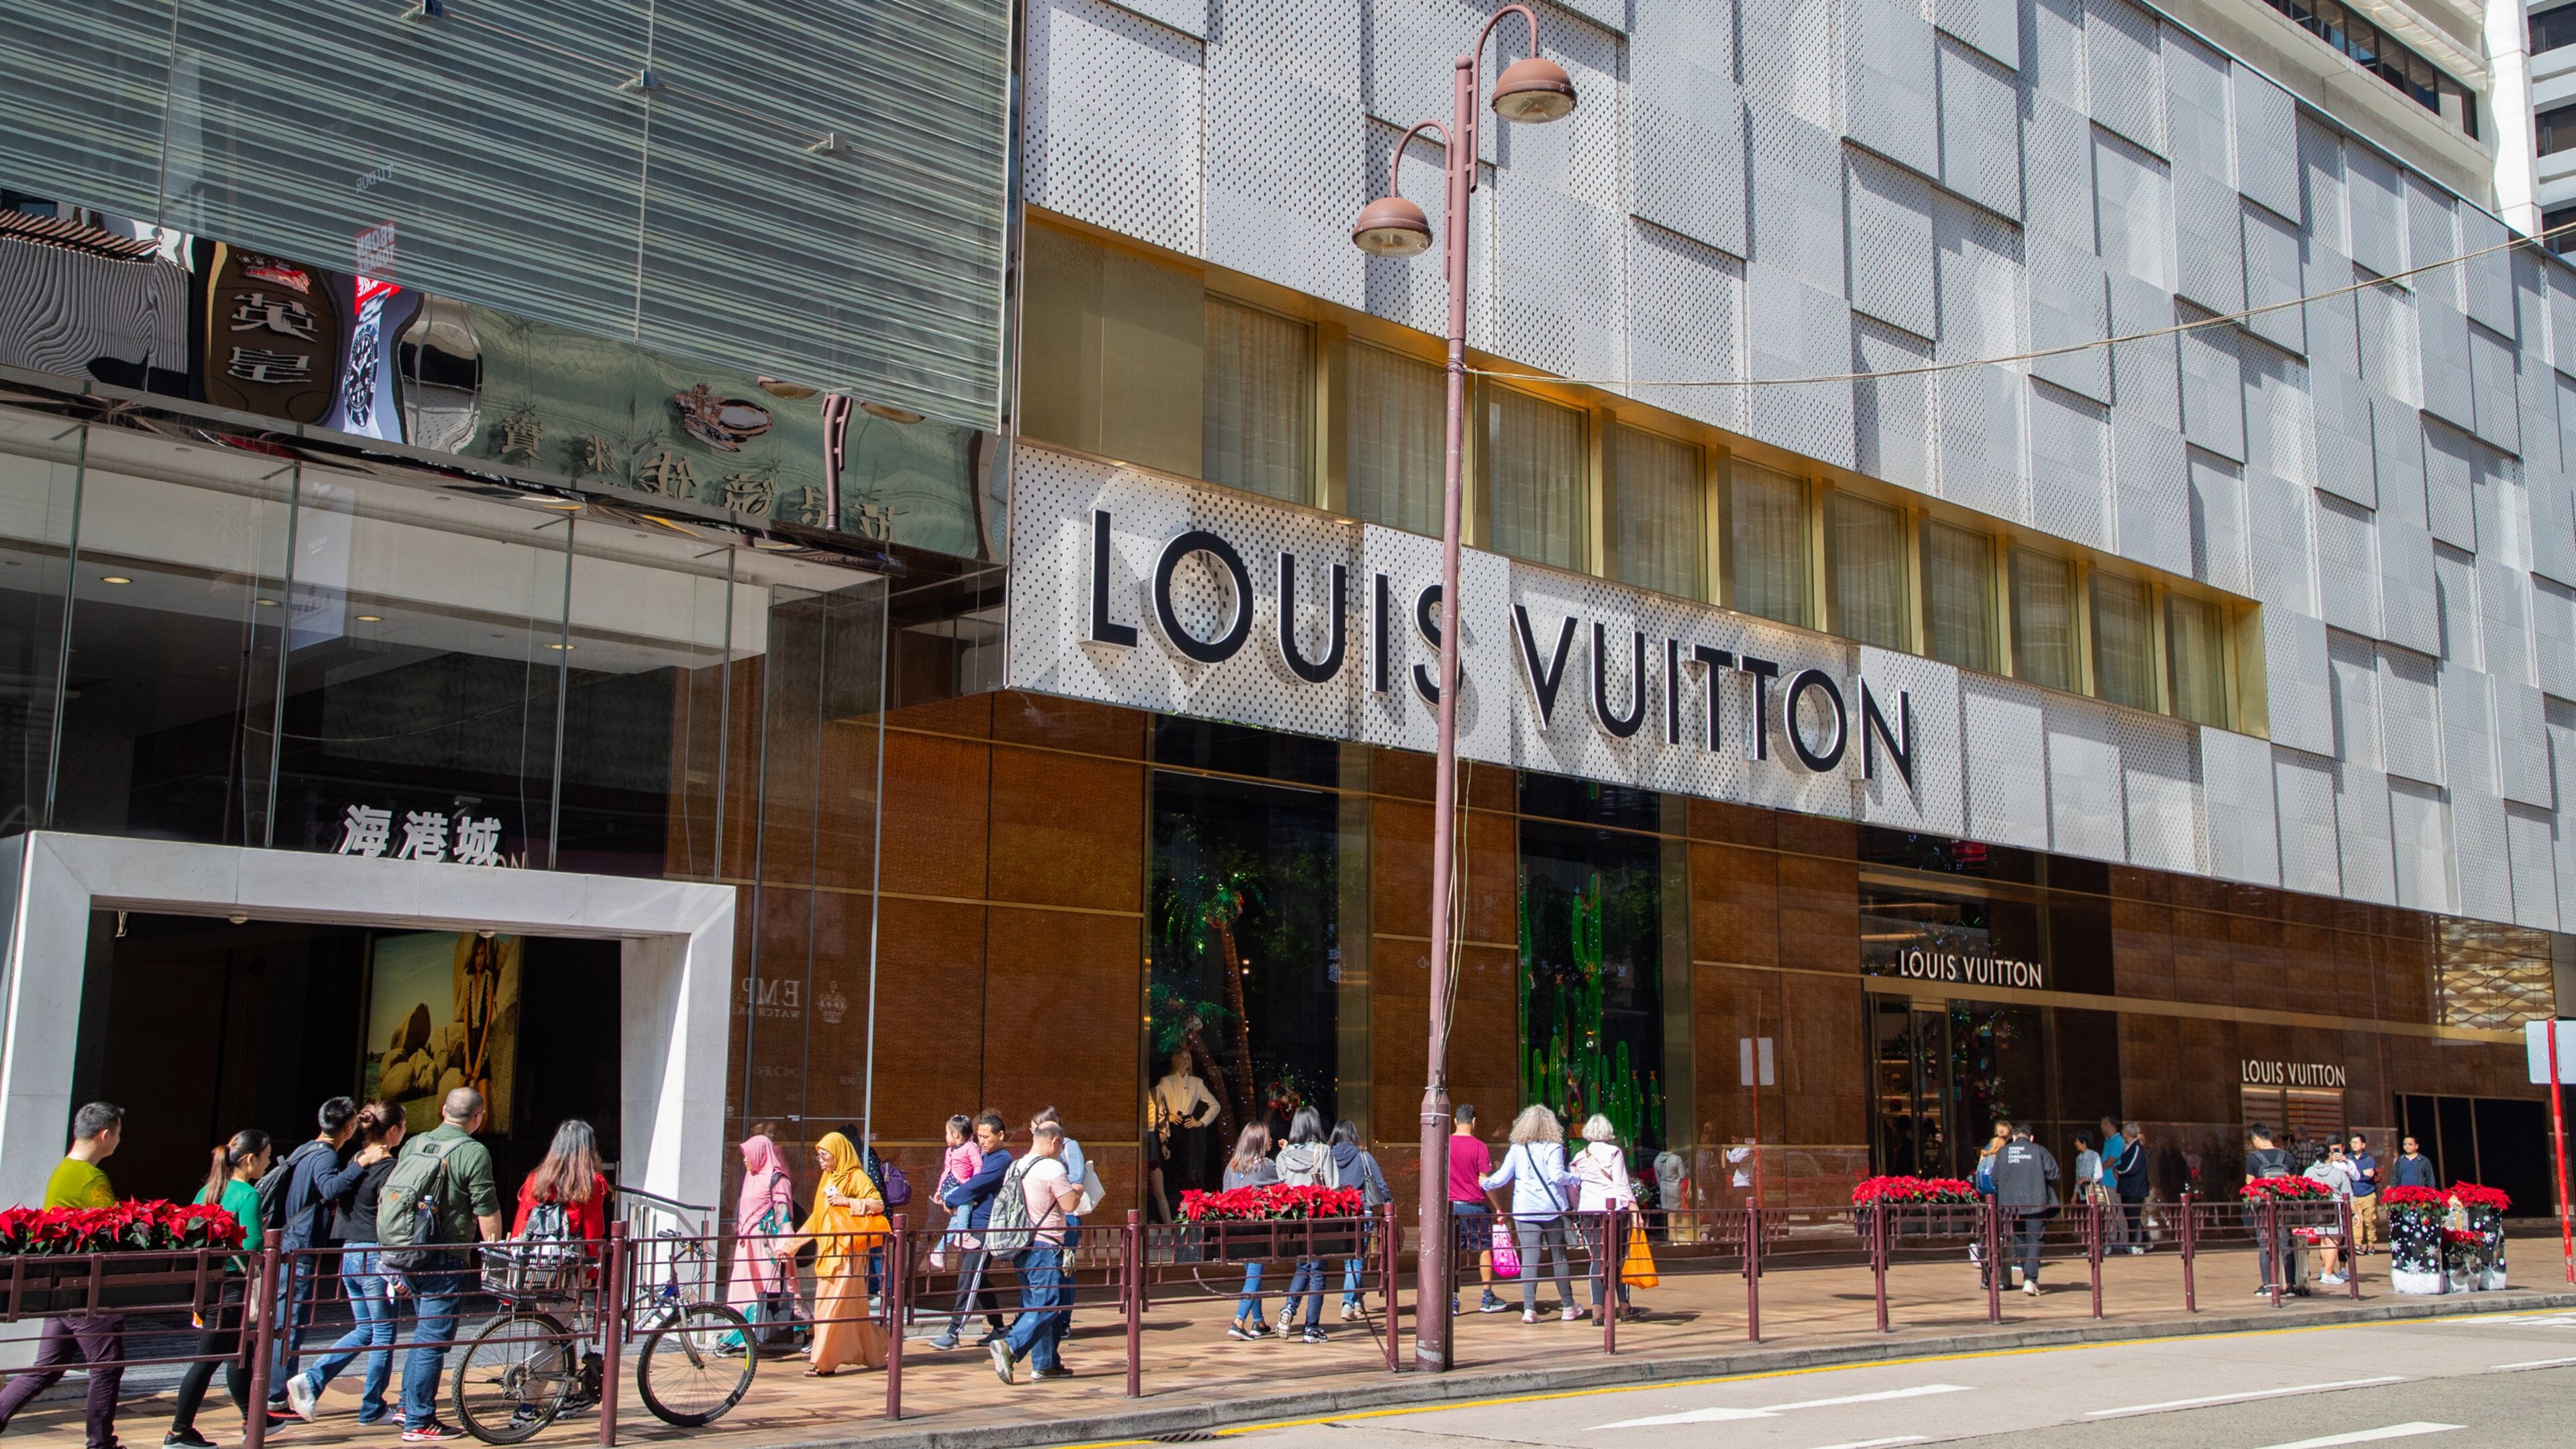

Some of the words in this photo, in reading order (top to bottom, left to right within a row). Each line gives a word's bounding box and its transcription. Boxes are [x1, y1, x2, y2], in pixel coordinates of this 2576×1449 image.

[1090, 508, 1463, 705] LOUIS
[1510, 604, 1912, 794] VUITTON
[338, 804, 502, 867] 海港城
[1900, 949, 1957, 981] LOUIS
[1962, 955, 2043, 989] VUITTON
[2242, 1059, 2284, 1084] LOUIS
[2288, 1062, 2346, 1087] VUITTON
